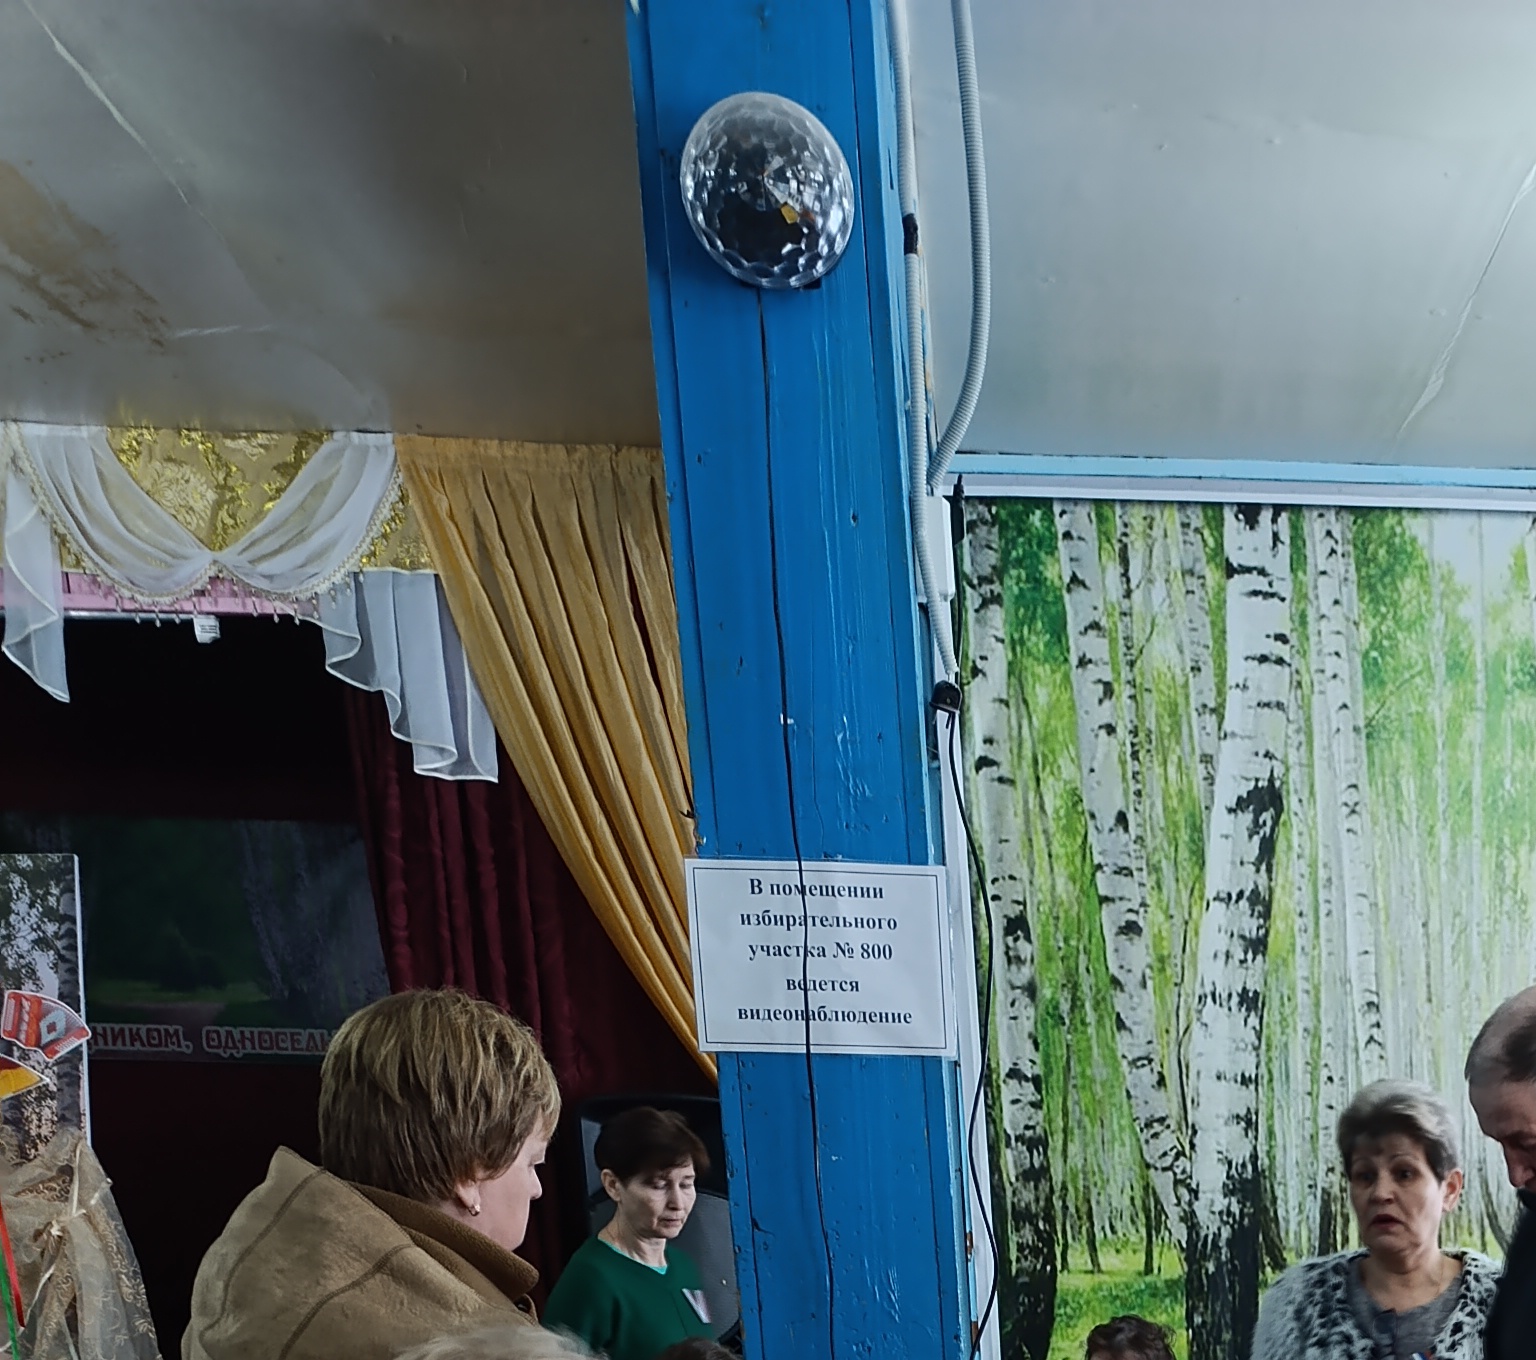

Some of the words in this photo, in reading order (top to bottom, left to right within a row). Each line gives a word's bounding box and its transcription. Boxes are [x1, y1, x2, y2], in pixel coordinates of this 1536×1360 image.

[749, 878, 764, 896] В
[770, 881, 884, 899] помещении
[740, 910, 898, 932] избирательного
[748, 943, 827, 961] участка
[832, 942, 855, 959] №
[860, 943, 893, 961] 800
[786, 977, 860, 993] ведется
[737, 1005, 913, 1025] видеонаблюдение
[88, 1025, 192, 1052] НИКОМ,
